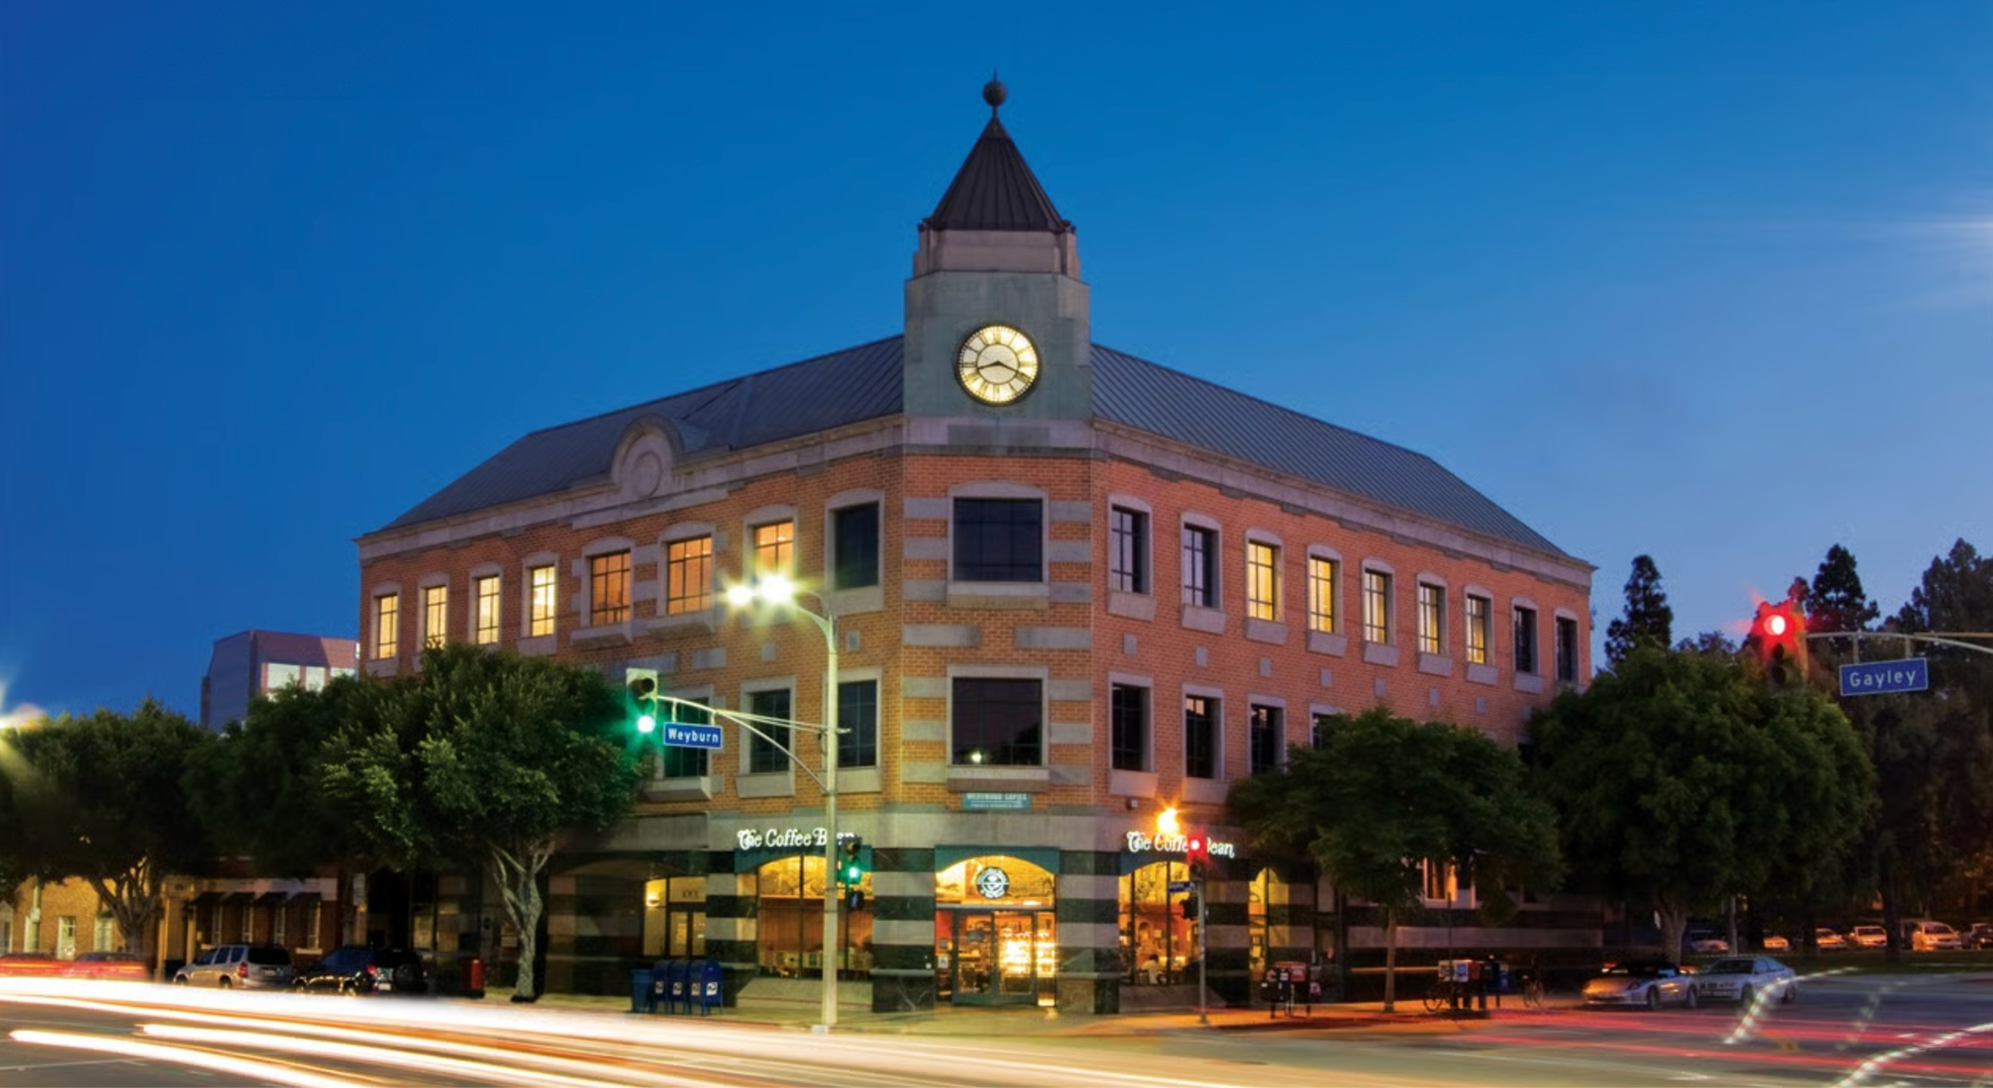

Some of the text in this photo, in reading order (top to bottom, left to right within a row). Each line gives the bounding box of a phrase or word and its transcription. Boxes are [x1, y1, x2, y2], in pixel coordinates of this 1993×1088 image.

[1849, 669, 1917, 689] Gayley
[667, 727, 719, 744] Weyburn
[737, 828, 763, 850] The
[765, 827, 813, 848] Coffee
[1126, 830, 1152, 853] The
[1154, 833, 1190, 853] Coffe
